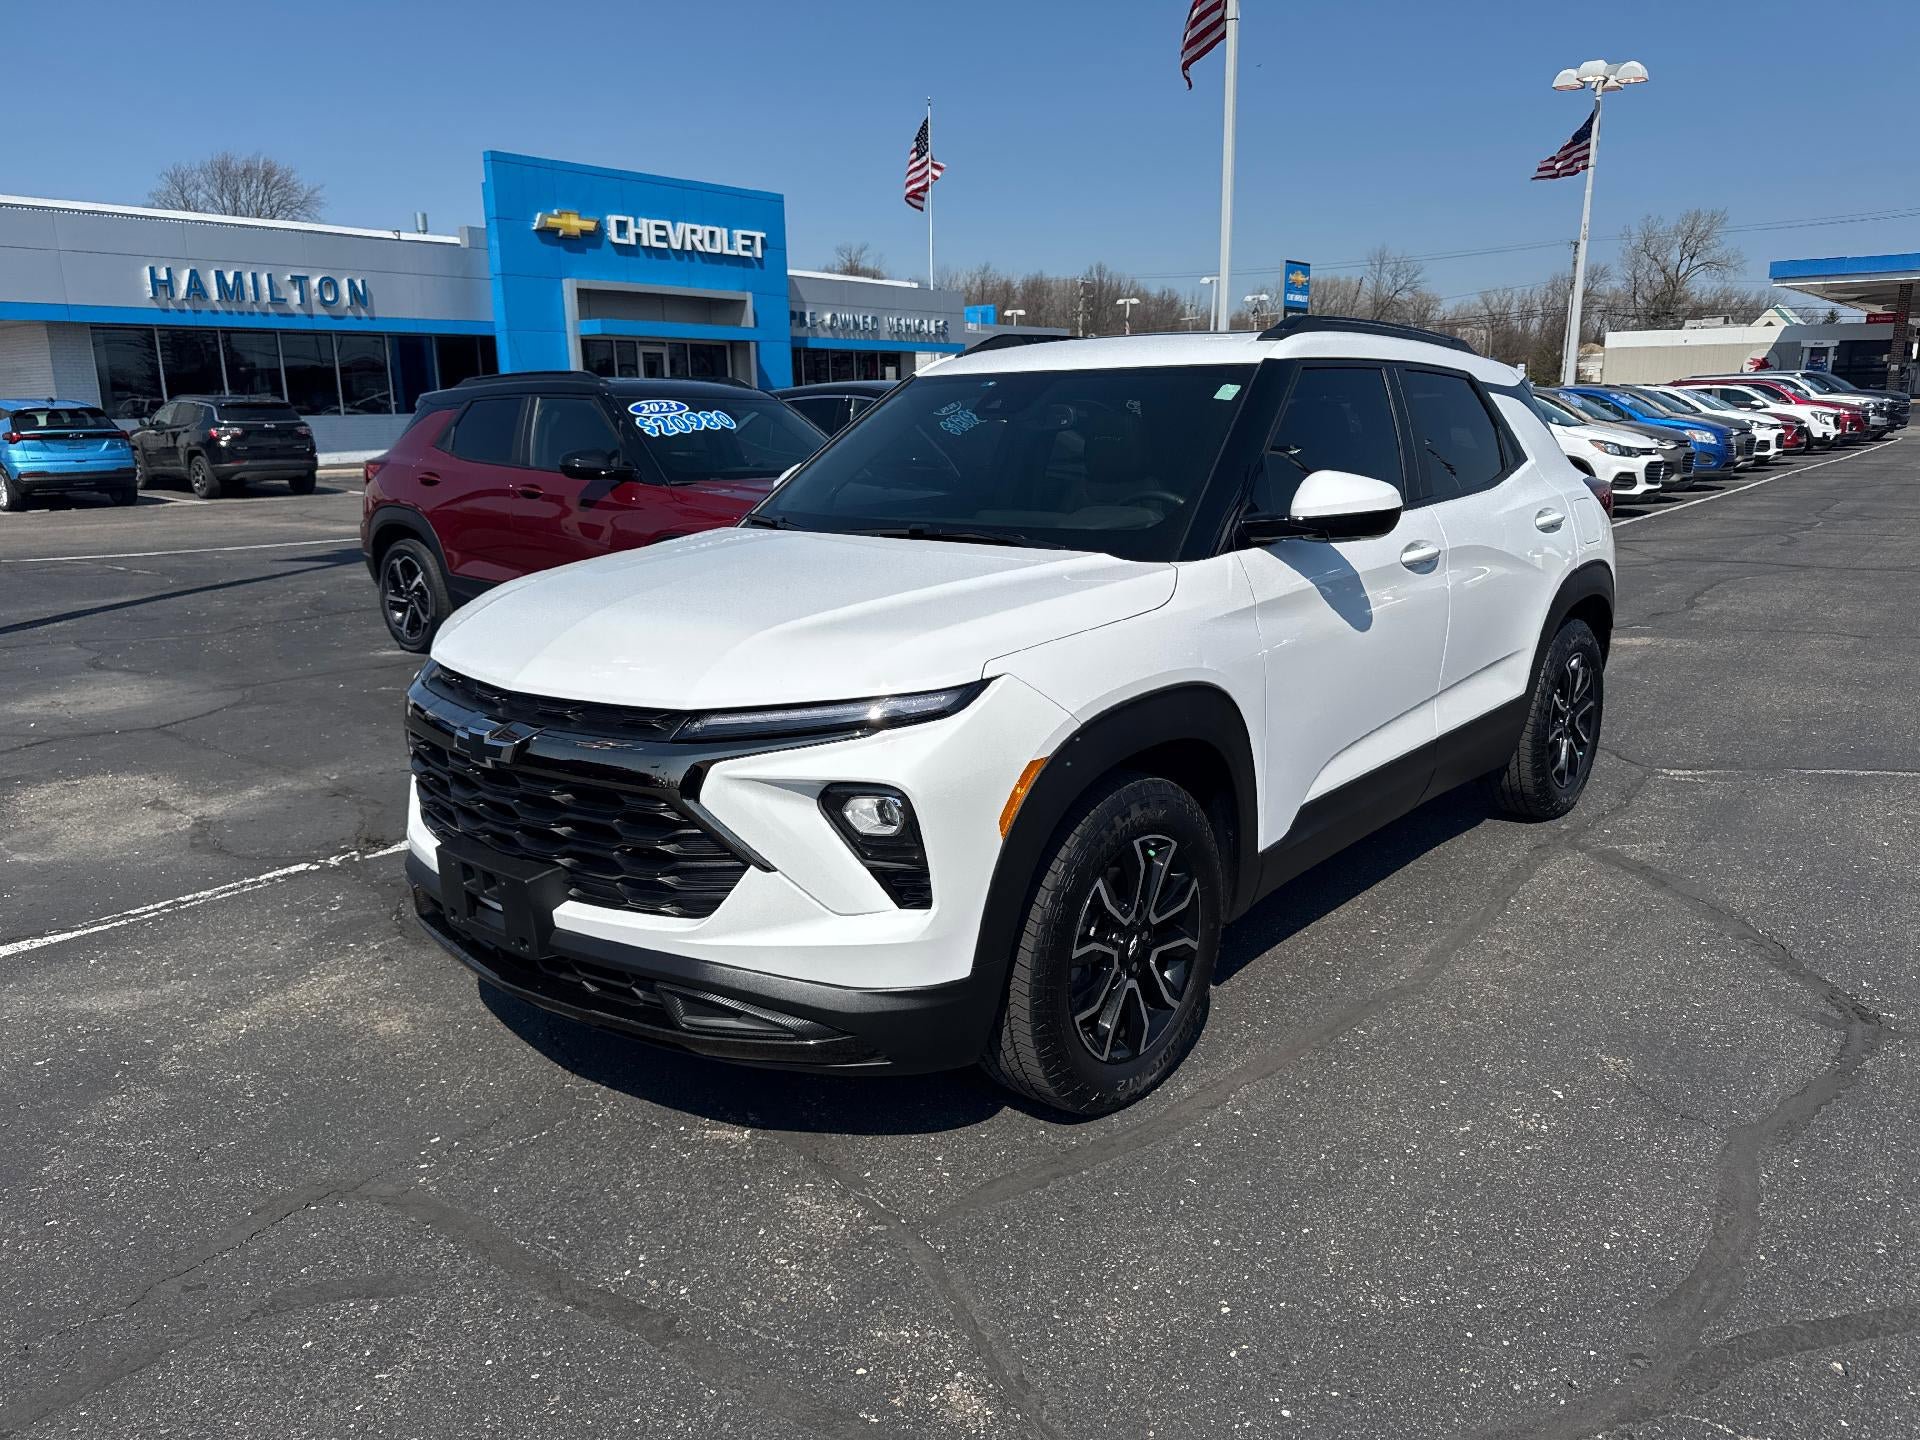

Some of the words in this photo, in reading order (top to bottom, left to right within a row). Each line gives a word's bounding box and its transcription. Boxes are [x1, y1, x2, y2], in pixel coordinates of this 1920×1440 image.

[608, 213, 767, 259] CHEVROLET
[147, 265, 369, 309] HAMILTON
[887, 317, 949, 336] VEHICLES
[640, 401, 679, 414] 2023
[635, 410, 737, 437] $20980
